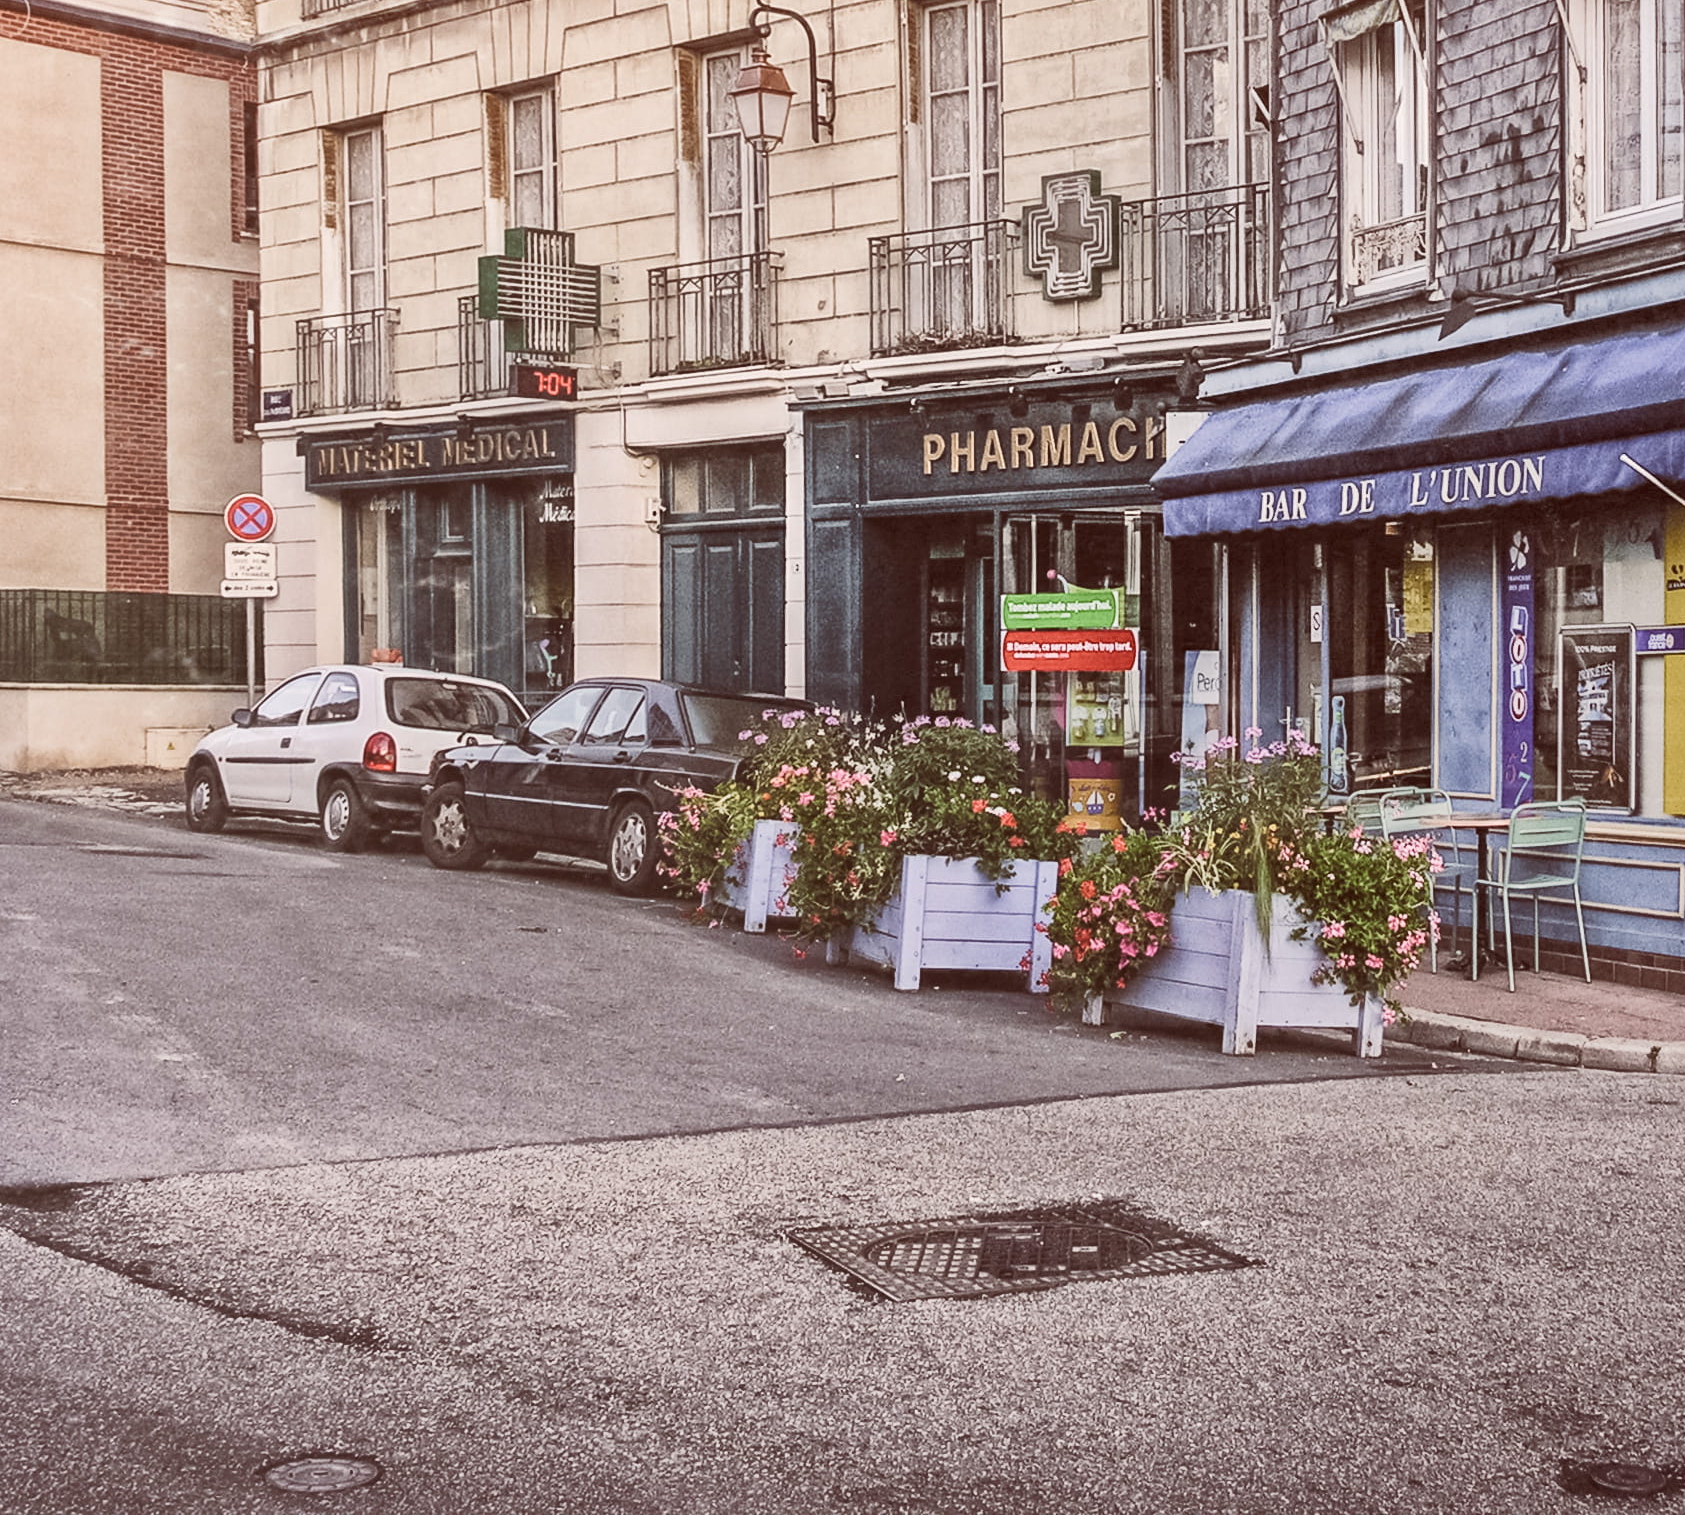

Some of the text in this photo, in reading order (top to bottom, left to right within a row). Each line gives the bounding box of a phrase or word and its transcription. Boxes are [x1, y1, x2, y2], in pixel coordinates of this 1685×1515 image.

[533, 372, 573, 395] 7:04
[1258, 455, 1546, 523] BAR DE L'UNION
[1509, 604, 1529, 722] LOTO
[1519, 742, 1528, 764] 2
